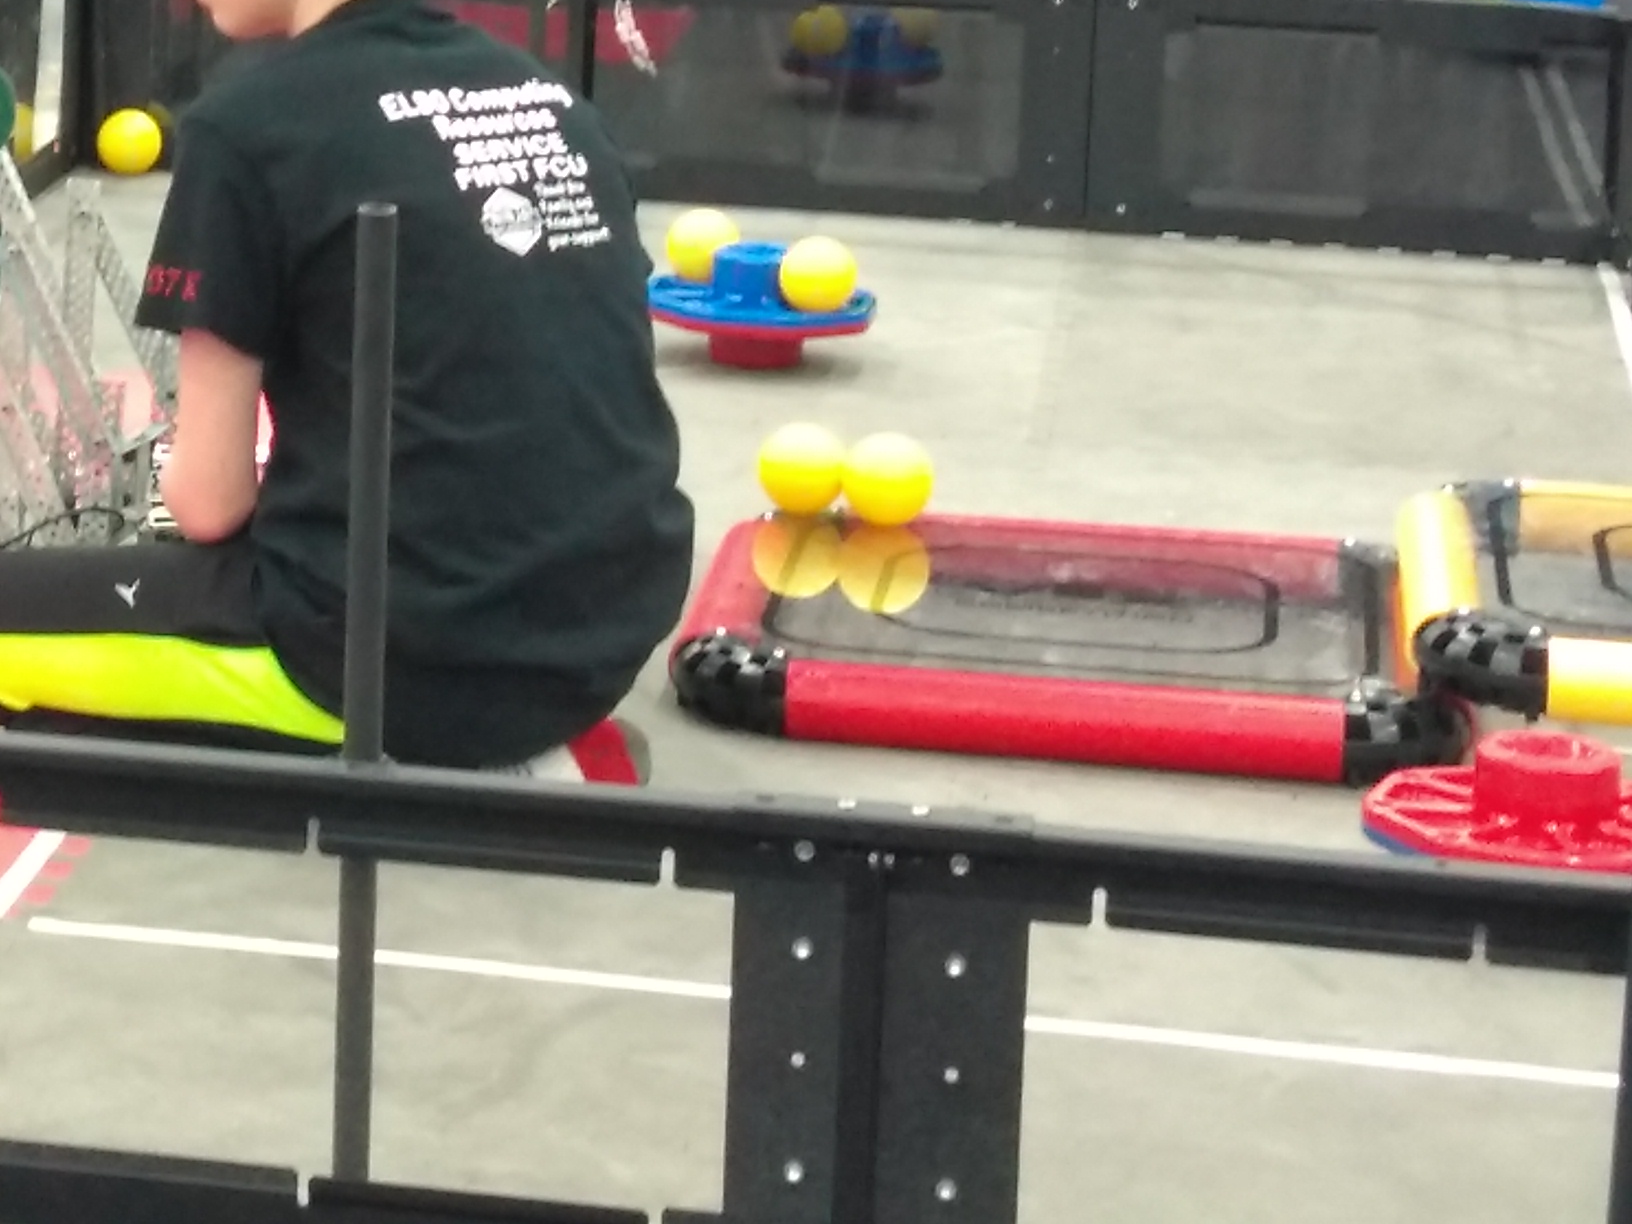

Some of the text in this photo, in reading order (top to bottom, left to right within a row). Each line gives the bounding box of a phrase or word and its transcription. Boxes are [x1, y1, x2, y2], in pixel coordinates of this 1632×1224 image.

[453, 131, 568, 166] SERVICE
[454, 158, 530, 192] FIRST
[532, 152, 589, 181] FCU
